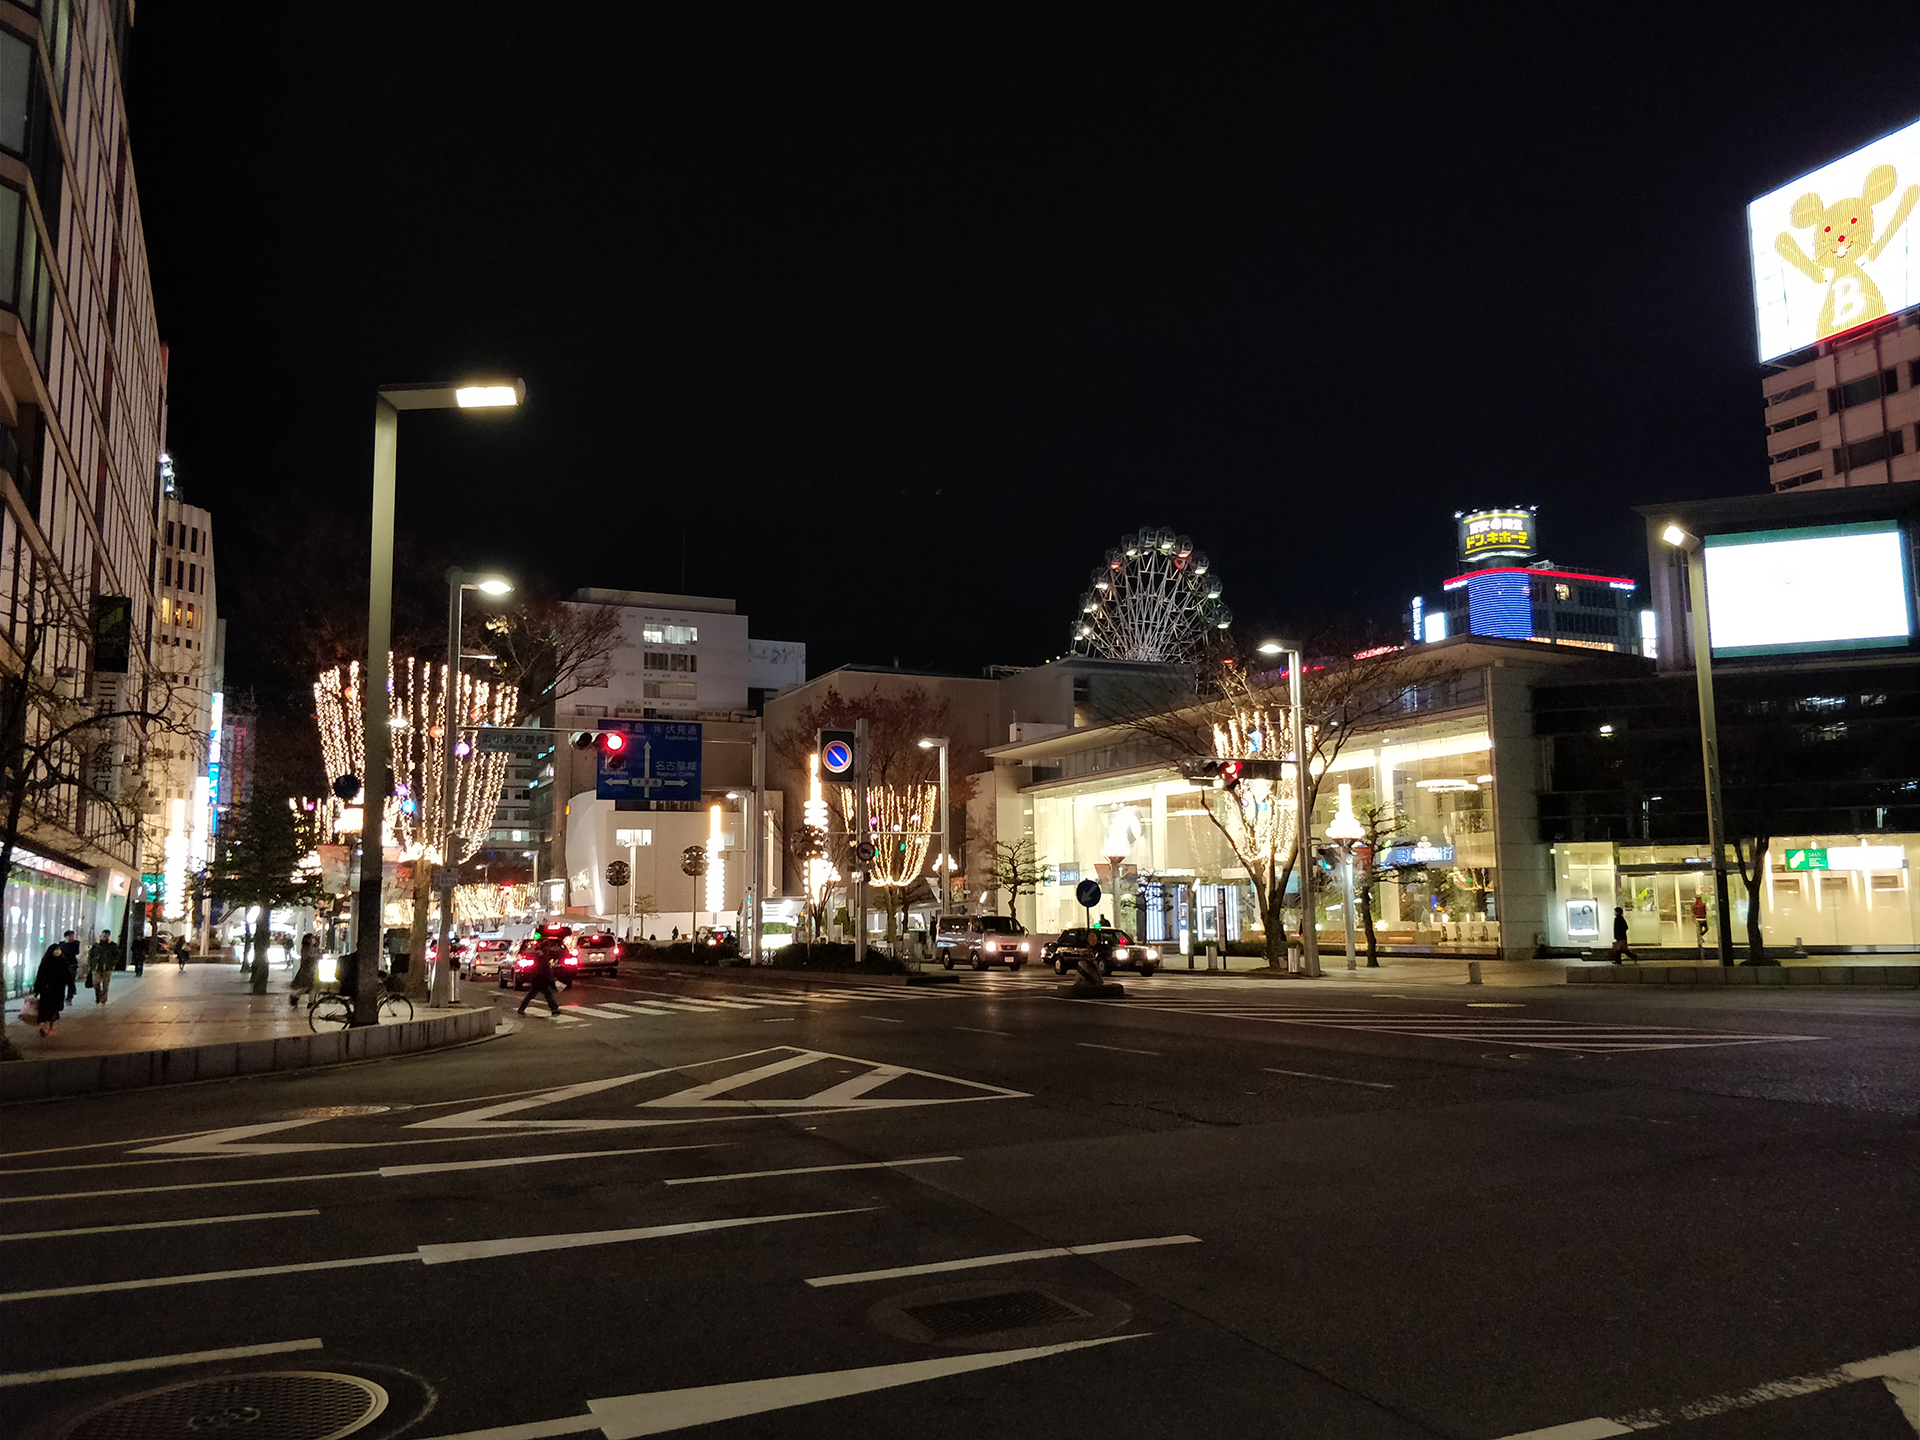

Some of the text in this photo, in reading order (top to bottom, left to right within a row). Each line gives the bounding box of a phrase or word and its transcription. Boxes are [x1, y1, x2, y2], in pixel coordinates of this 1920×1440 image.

[1831, 277, 1865, 326] B
[666, 724, 697, 735] 伏見通
[655, 761, 697, 771] 名古屋城
